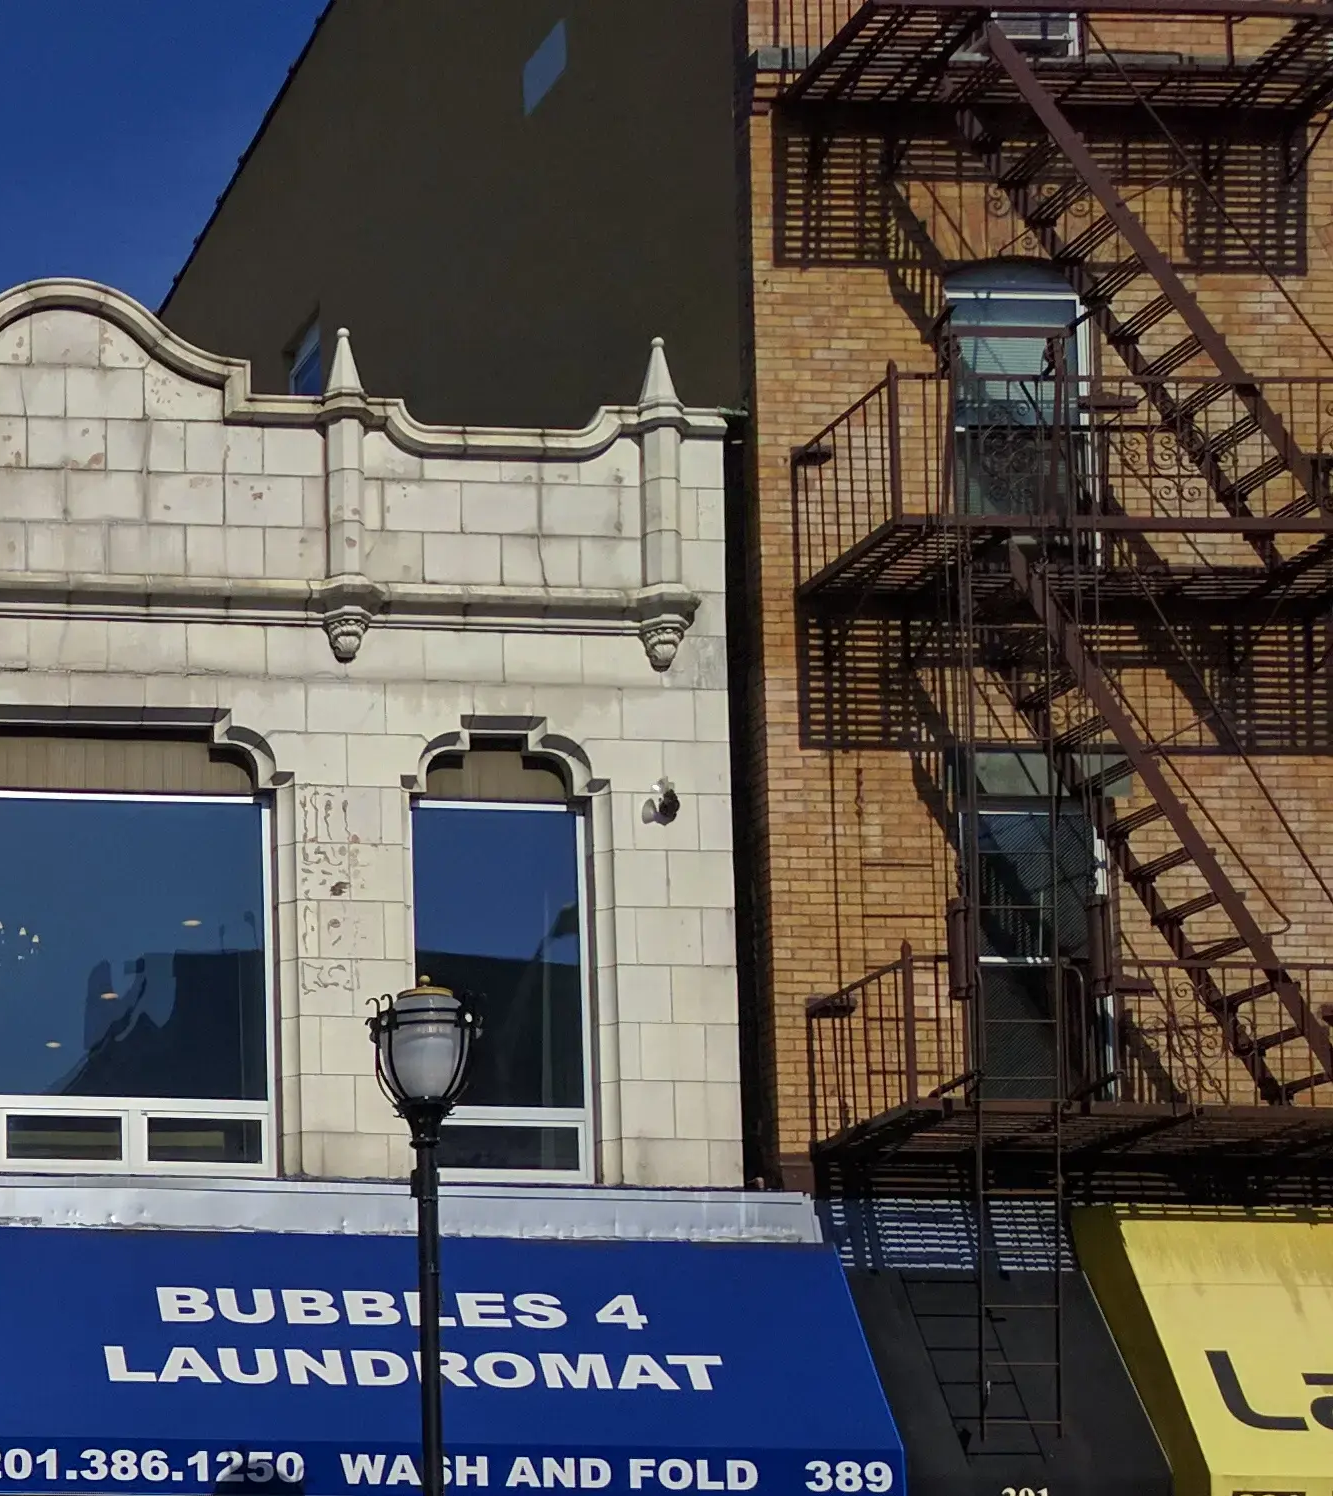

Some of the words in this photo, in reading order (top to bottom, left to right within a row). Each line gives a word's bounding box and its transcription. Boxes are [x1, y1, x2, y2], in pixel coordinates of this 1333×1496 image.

[156, 1286, 568, 1330] BUBBLES
[594, 1294, 649, 1330] 4
[103, 1345, 724, 1391] LAUNDROMAT
[505, 1456, 612, 1489] AND
[629, 1458, 758, 1491] FOLD
[804, 1460, 894, 1492] 389
